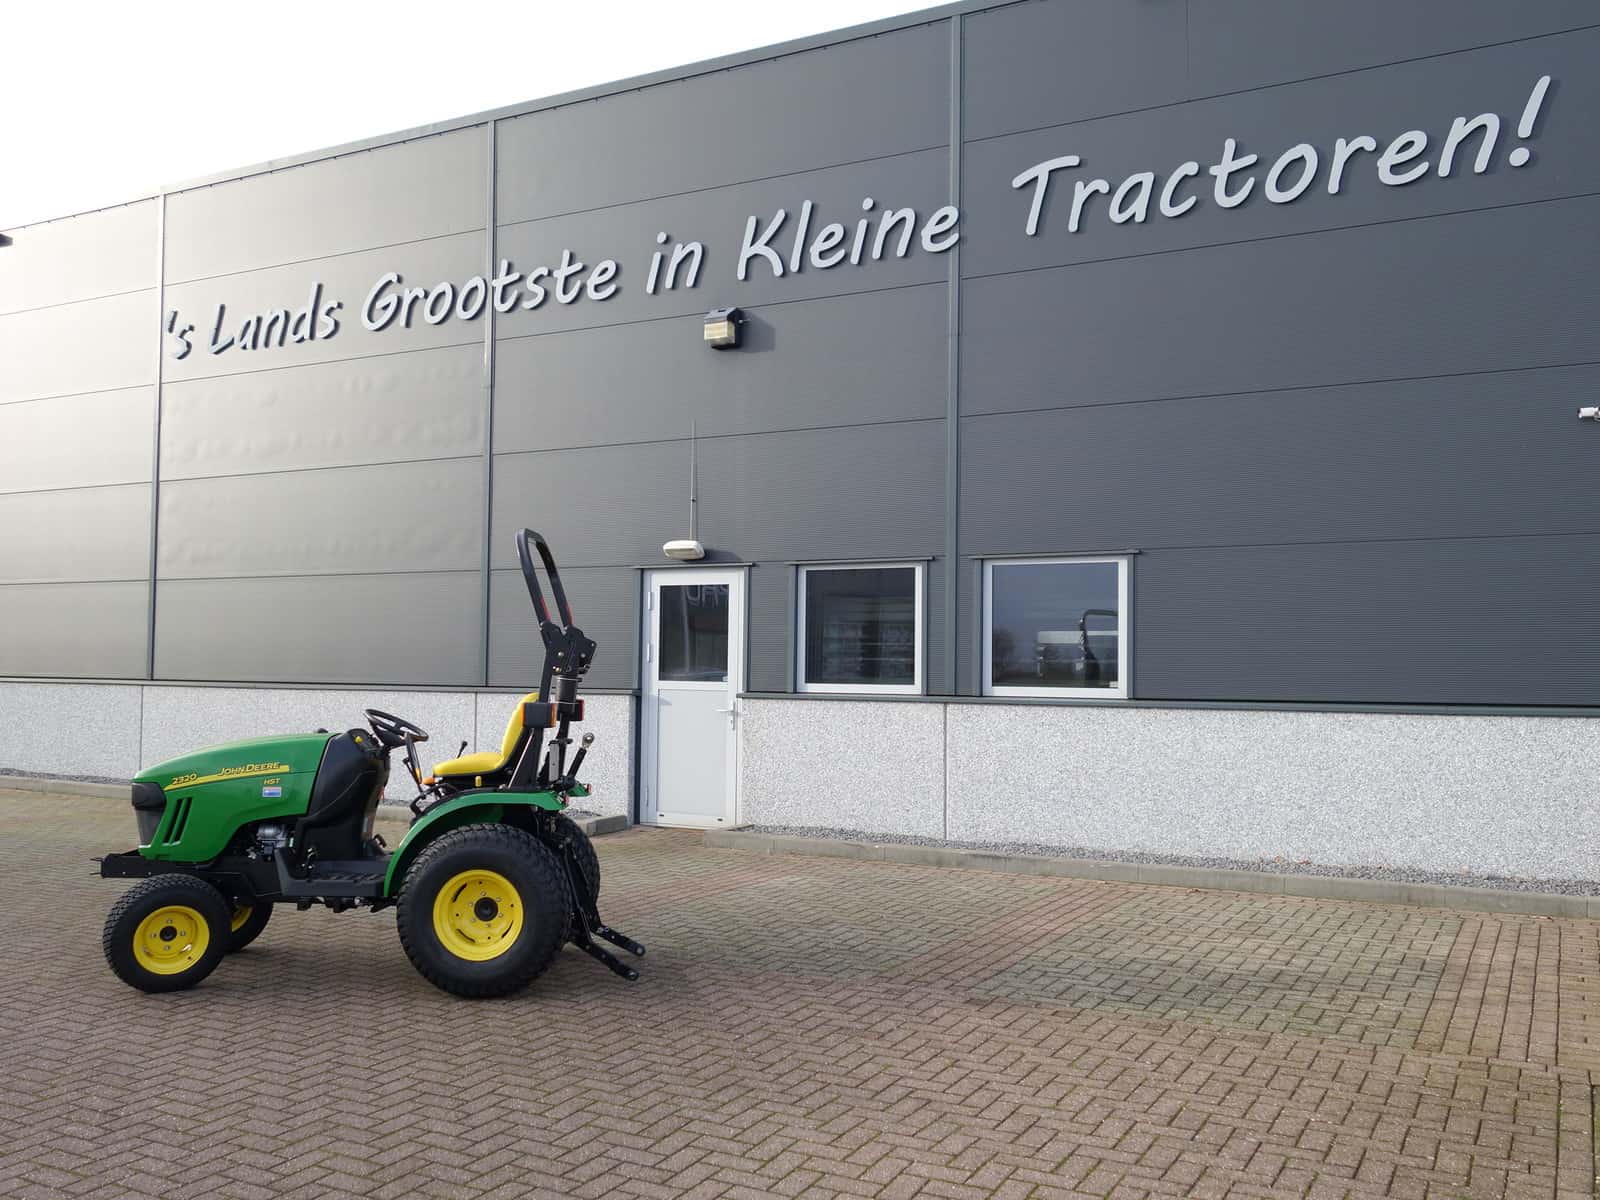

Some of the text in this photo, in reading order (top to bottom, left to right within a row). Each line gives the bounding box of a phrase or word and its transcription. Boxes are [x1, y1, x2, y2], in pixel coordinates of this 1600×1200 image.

[166, 75, 1551, 359] 's Lands Grootste in Kleine Tractoren!
[219, 762, 280, 776] JOHN DEERE
[172, 773, 197, 785] 2320
